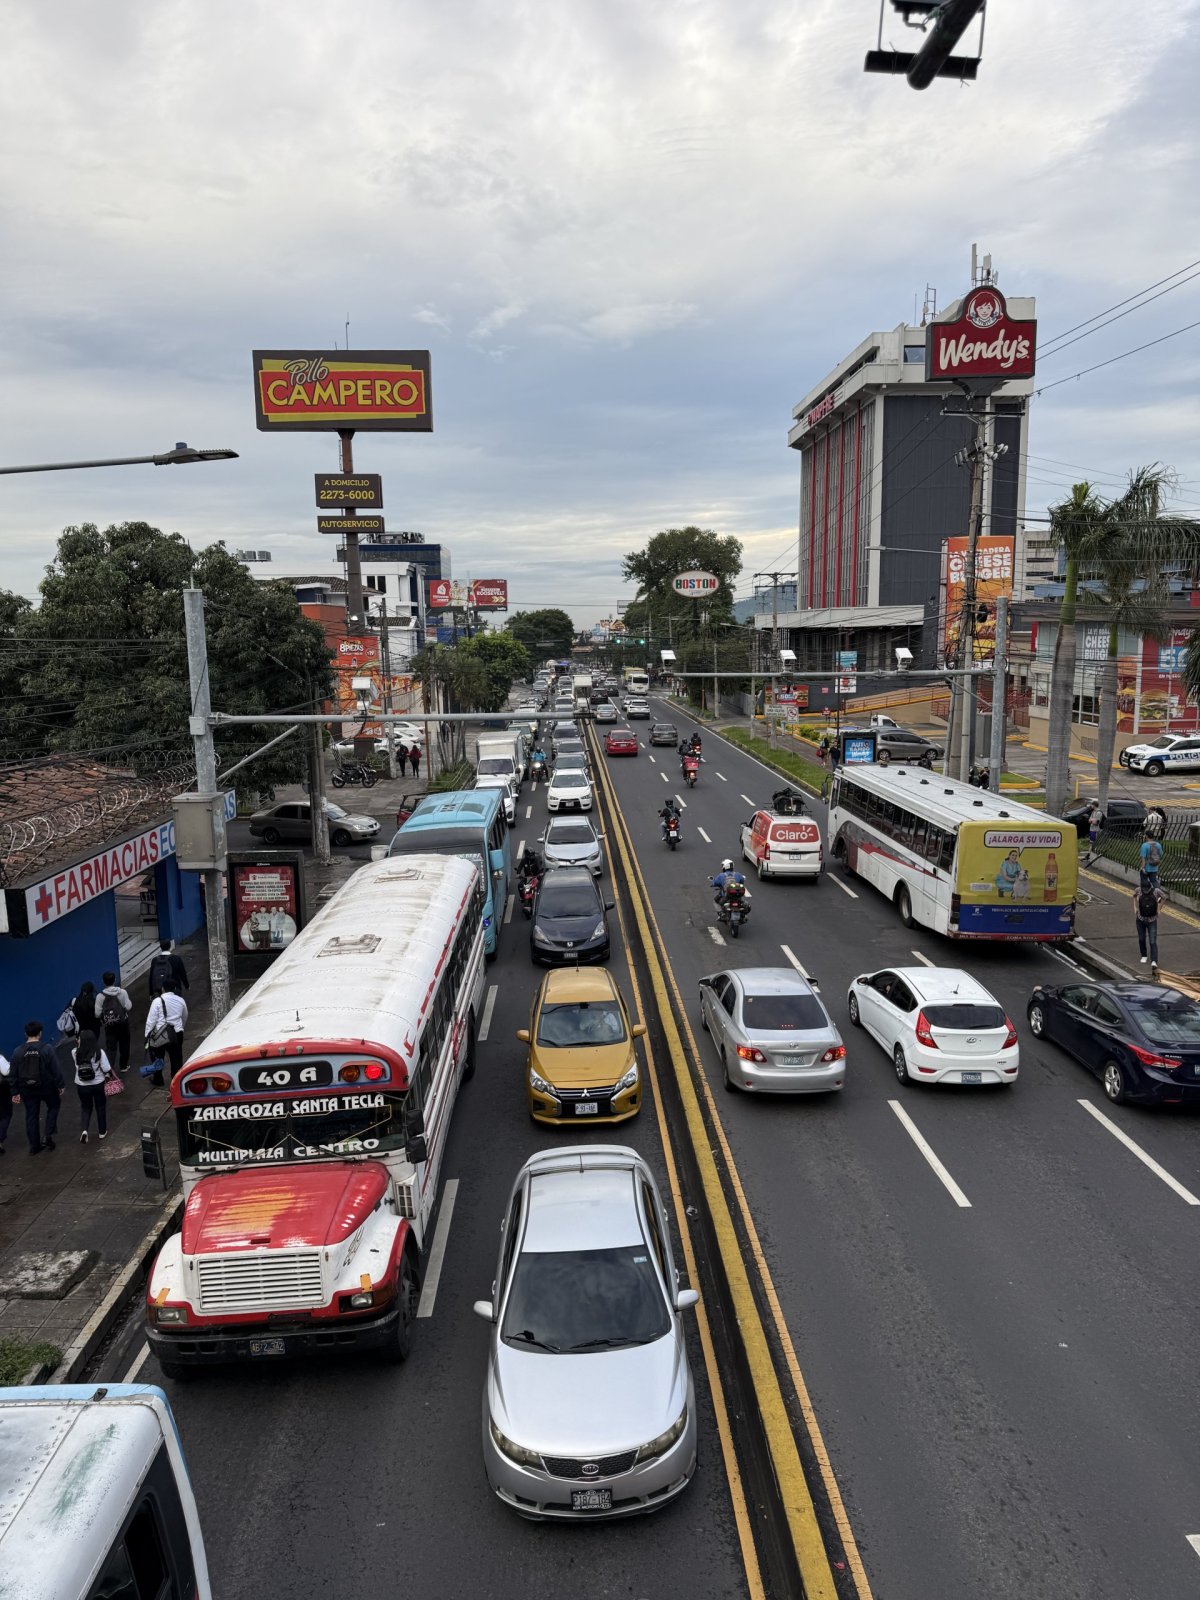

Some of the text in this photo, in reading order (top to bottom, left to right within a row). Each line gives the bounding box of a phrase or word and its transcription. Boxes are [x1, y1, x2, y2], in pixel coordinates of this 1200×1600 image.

[939, 328, 1030, 371] Wendy's
[284, 357, 330, 386] Pollo
[266, 379, 419, 406] CAMPERO
[320, 490, 375, 500] 2273-6000
[320, 520, 380, 528] AUTOSERVICIO
[675, 579, 716, 589] BOSTON
[776, 829, 809, 841] Claro
[988, 835, 1060, 845] ¡ALARGA SU VIDA!
[53, 830, 160, 915] FARMACIAS
[257, 1067, 317, 1086] 40 A
[193, 1094, 385, 1121] ZARAGOZA SANTA TECLA
[198, 1138, 380, 1162] MULTIPLAZA CENTRO
